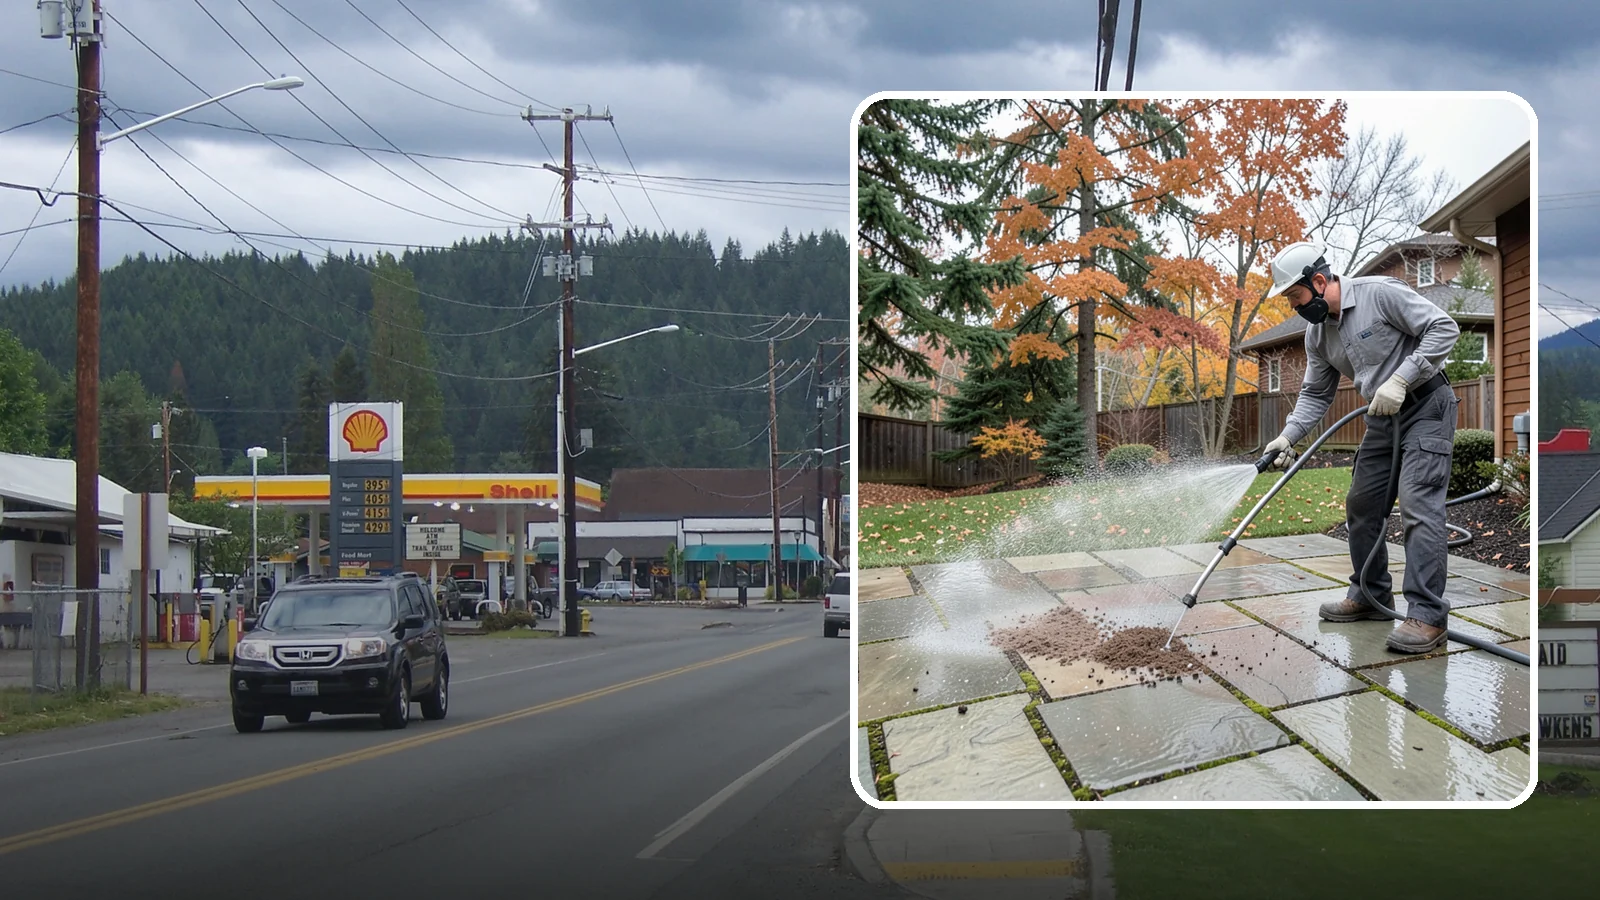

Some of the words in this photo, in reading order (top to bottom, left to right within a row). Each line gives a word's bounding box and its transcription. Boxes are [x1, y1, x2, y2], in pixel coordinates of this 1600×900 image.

[366, 480, 383, 490] 395
[490, 484, 547, 498] Shell
[365, 494, 383, 504] 405
[365, 508, 383, 518] 415
[365, 522, 383, 532] 429
